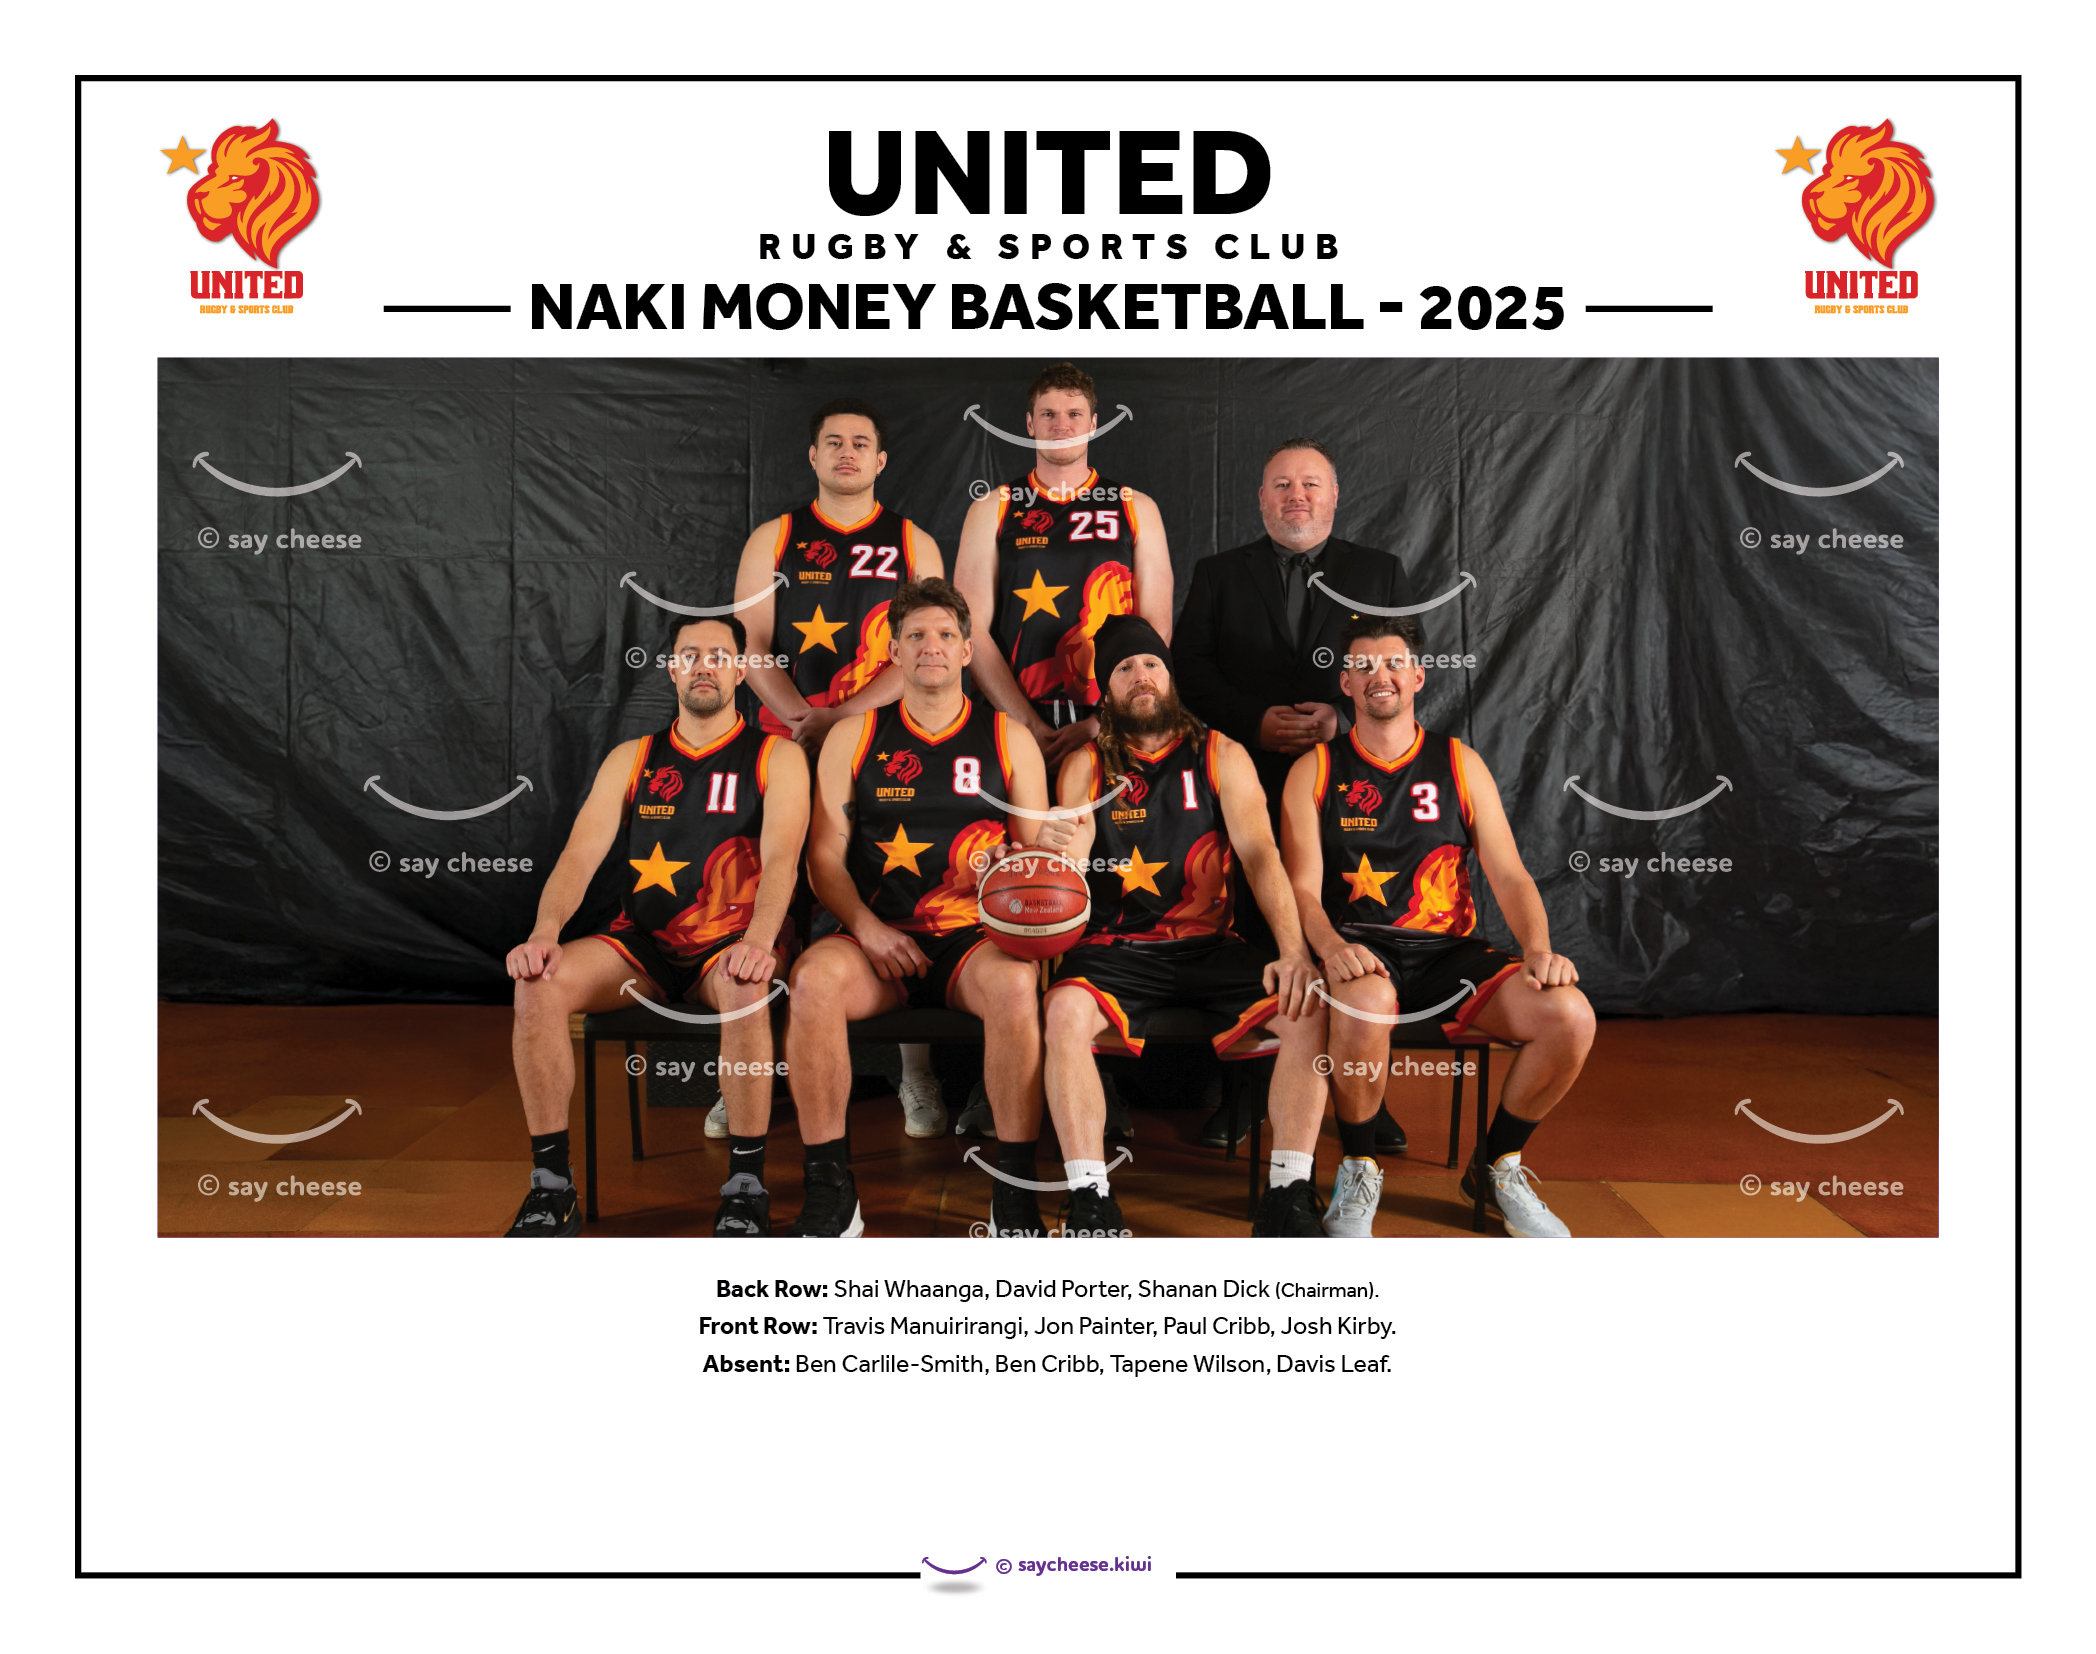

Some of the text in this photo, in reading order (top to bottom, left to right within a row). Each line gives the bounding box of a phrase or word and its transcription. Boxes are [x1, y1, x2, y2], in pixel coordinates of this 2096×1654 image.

[1069, 510, 1120, 542] 25
[1015, 536, 1049, 546] UNITED
[849, 545, 899, 579] 22
[798, 571, 832, 581] UNITED
[952, 756, 981, 796] 8
[706, 772, 740, 813] 11
[876, 787, 915, 797] UNITED
[1180, 769, 1199, 811] 1
[638, 804, 675, 815] UNITED
[1410, 782, 1439, 822] 3
[1111, 808, 1147, 820] UNITED
[1340, 817, 1377, 827] UNITED
